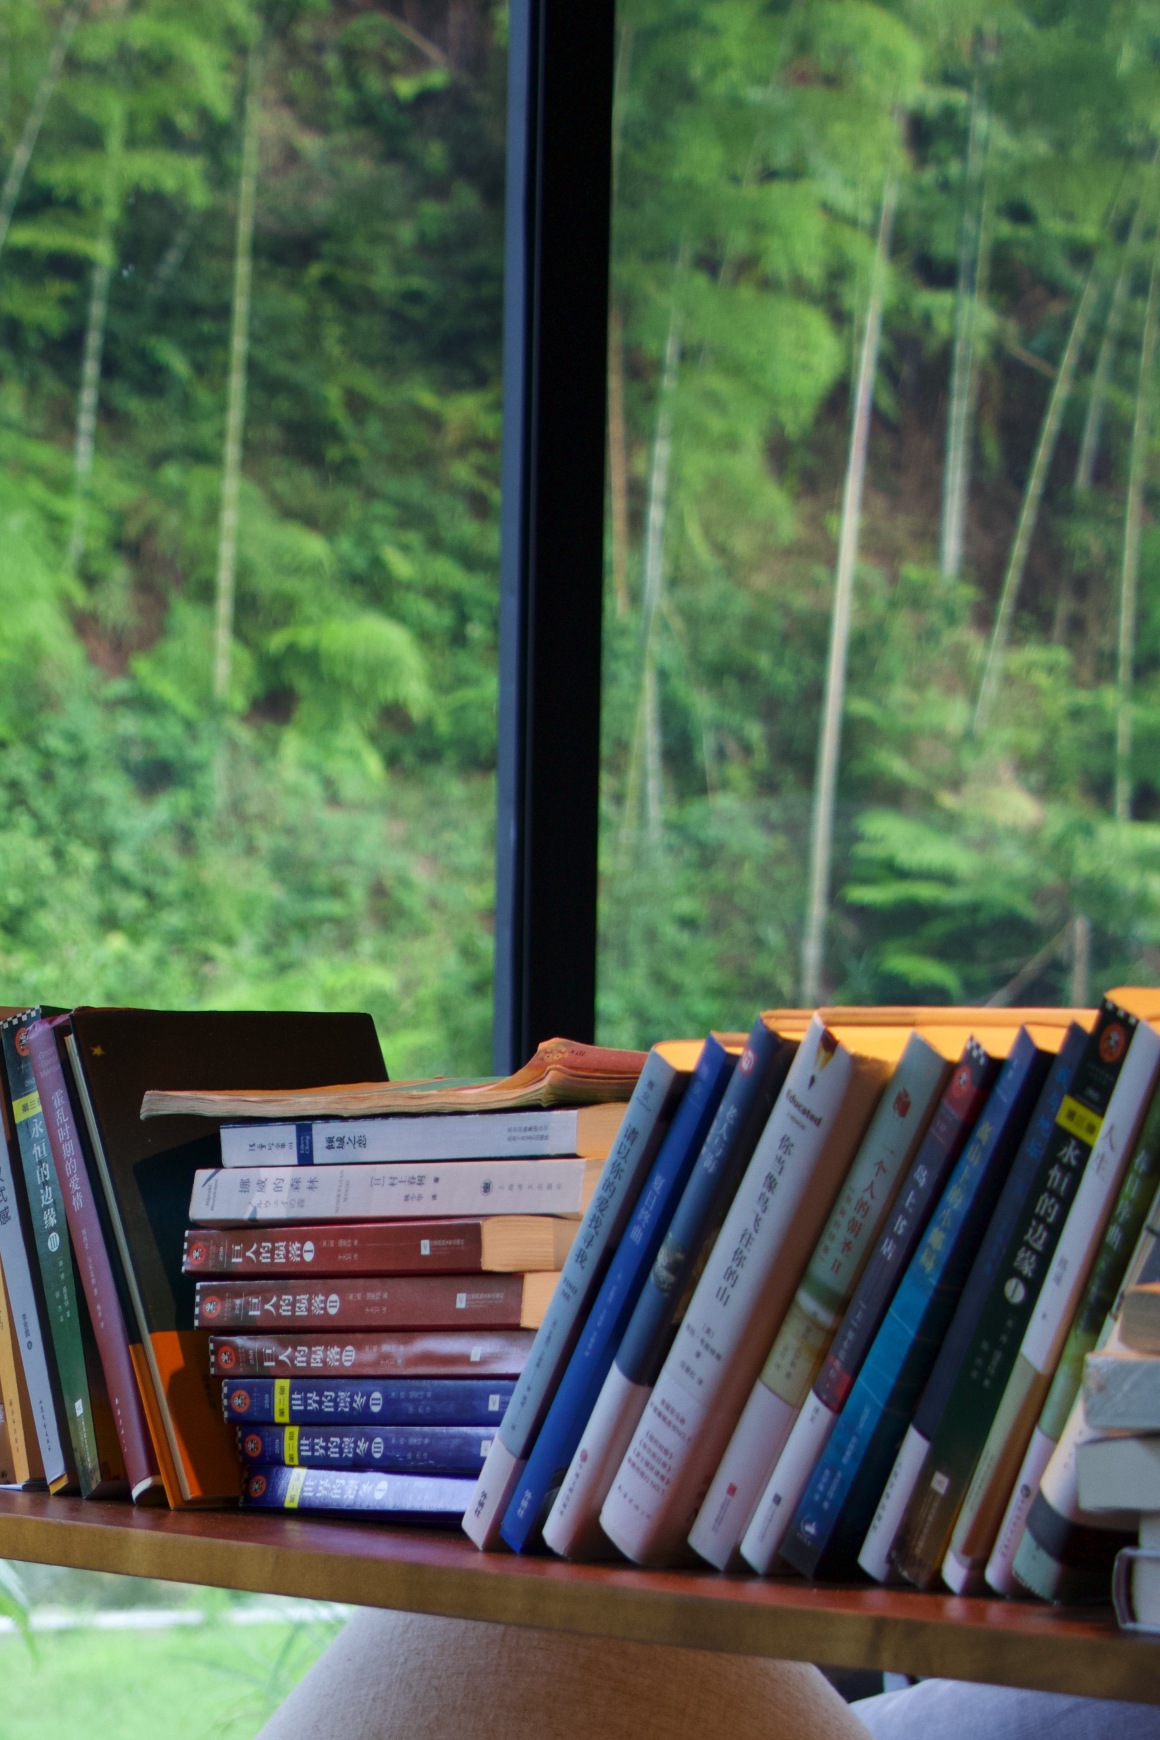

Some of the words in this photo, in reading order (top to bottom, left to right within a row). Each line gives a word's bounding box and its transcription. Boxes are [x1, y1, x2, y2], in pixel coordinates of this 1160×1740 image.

[784, 1089, 823, 1129] Educated
[51, 1089, 84, 1213] 霍乱时期的爱情
[325, 1134, 367, 1151] 倾城之恋
[703, 1104, 738, 1174] 老人与海
[1091, 1121, 1117, 1176] 人生
[30, 1118, 58, 1229] 永恒的边缘
[238, 1176, 320, 1194] 挪威的森林
[573, 1122, 639, 1271] 请以你的爱找寻我
[629, 1174, 667, 1246] 夏日终曲
[879, 1163, 928, 1262] 岛上书店
[918, 1119, 993, 1273] 高山上的小邮局
[1012, 1138, 1083, 1279] 永恒的边缘
[715, 1133, 795, 1308] 你当像鸟飞往你的山
[231, 1241, 303, 1264] 巨人的陨落
[247, 1293, 326, 1316] 巨人的陨落
[262, 1345, 341, 1368] 巨人的陨落
[291, 1390, 367, 1413] 世界的凛冬
[299, 1436, 370, 1458] 世界的凛冬
[302, 1478, 374, 1499] 世界的凛冬
[472, 1488, 488, 1520] 外研社
[516, 1488, 534, 1520] 外研社
